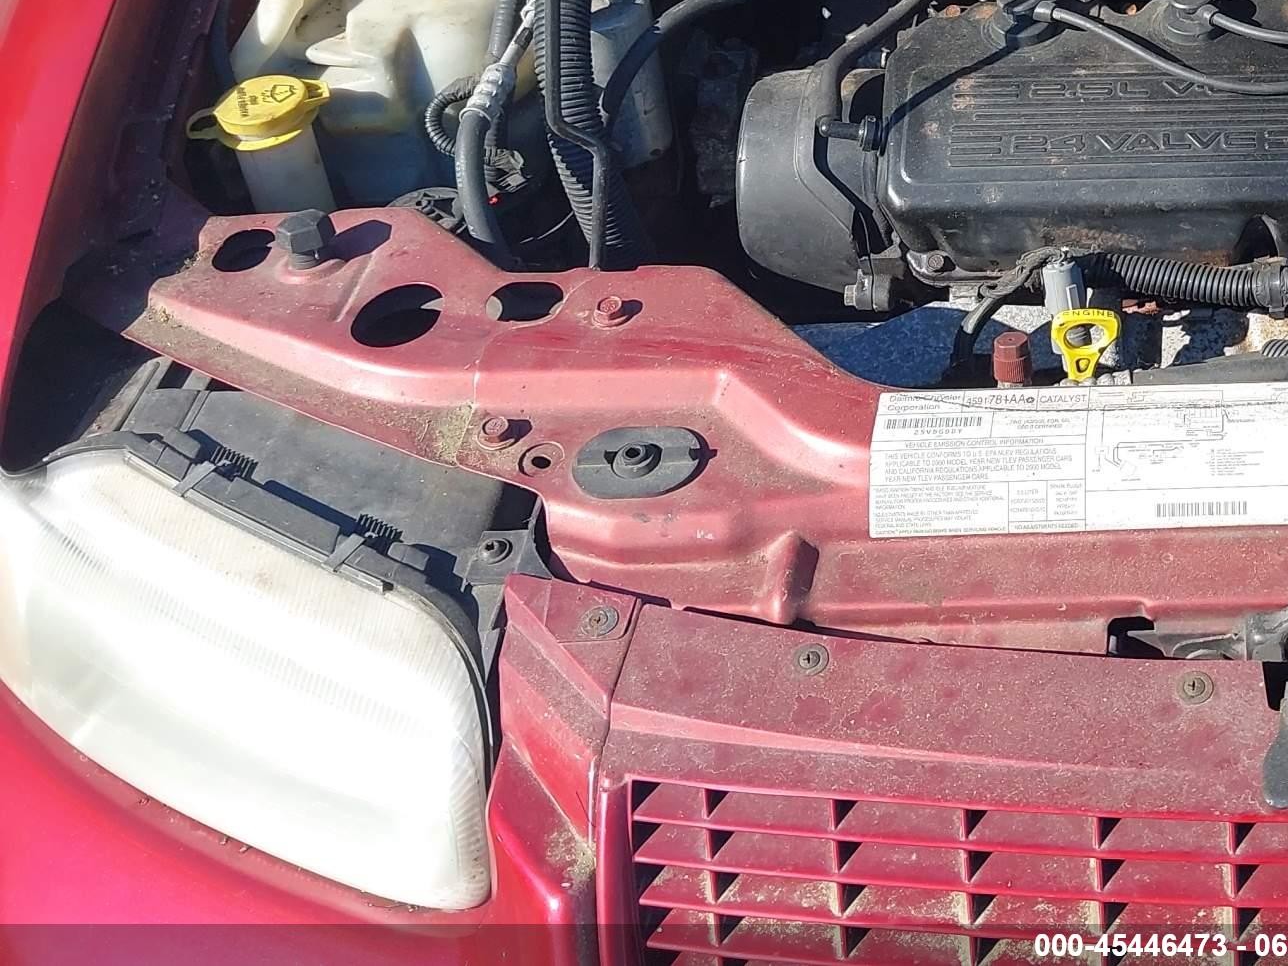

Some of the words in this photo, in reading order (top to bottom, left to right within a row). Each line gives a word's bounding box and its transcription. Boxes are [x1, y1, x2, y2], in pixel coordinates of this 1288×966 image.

[1029, 81, 1150, 99] 2.5L
[1010, 133, 1086, 155] 24
[1095, 131, 1258, 152] VALVE
[1062, 309, 1113, 318] ENGINE
[1039, 394, 1087, 403] CATALYST
[887, 403, 941, 411] Corporation
